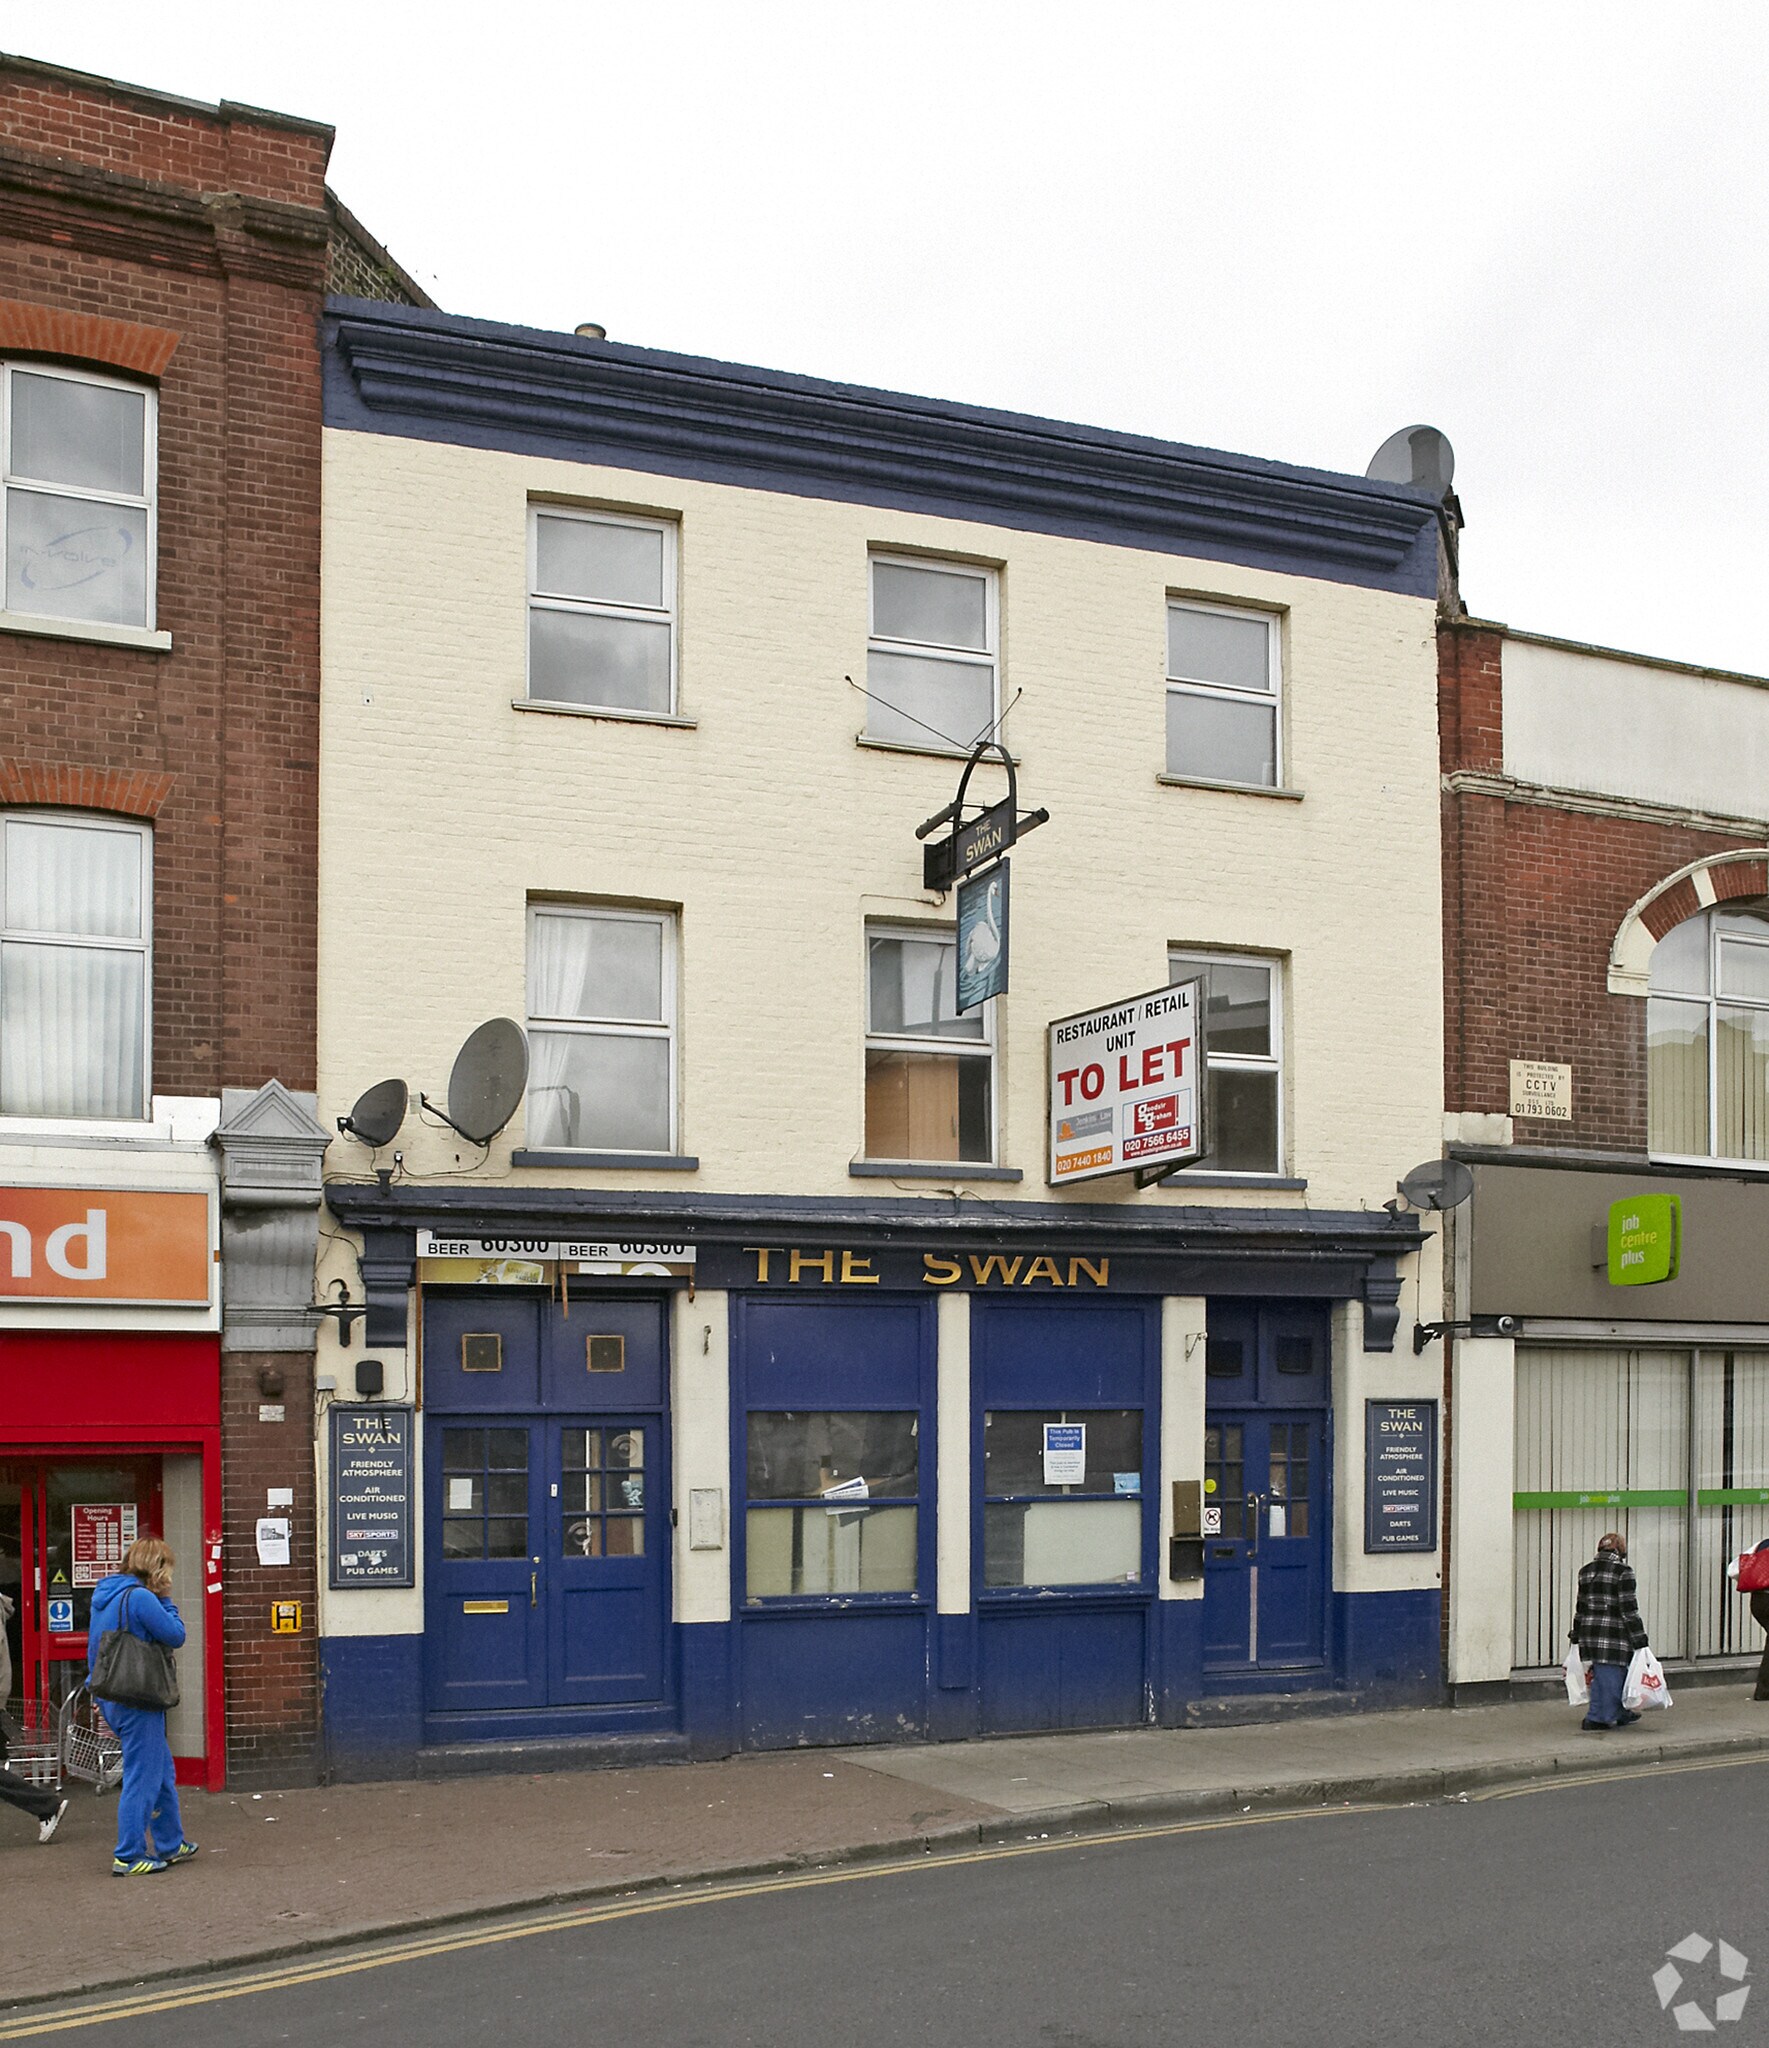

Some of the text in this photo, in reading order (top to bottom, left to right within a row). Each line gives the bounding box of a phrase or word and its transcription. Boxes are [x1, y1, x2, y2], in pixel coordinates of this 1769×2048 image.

[975, 818, 991, 838] THE
[966, 826, 1002, 862] SWAN
[1056, 1007, 1135, 1044] RESTAURANT
[1145, 992, 1190, 1019] RETAIL
[1106, 1030, 1136, 1052] UNIT
[1057, 1037, 1191, 1106] TO LET
[1526, 1079, 1556, 1091] CCTV
[1545, 1105, 1567, 1117] 0602
[1125, 1129, 1189, 1152] 020 7566 6455
[1057, 1150, 1111, 1171] 020 7440 1840
[1622, 1214, 1640, 1234] job
[1621, 1231, 1657, 1249] centre
[428, 1243, 469, 1255] BEER
[569, 1245, 609, 1257] BEER
[1621, 1250, 1645, 1270] plus
[743, 1247, 1110, 1287] THE SWAN
[1388, 1409, 1416, 1419] THE
[352, 1418, 392, 1429] THE
[1380, 1421, 1423, 1432] SWAN
[342, 1433, 401, 1444] SWAN
[350, 1460, 394, 1468] FRIENDLY
[342, 1469, 403, 1477] ATMOSPHERE
[364, 1486, 381, 1494] AIR
[339, 1495, 406, 1503] CONDITIONED
[83, 1507, 112, 1515] Opening
[368, 1512, 399, 1520] MUSIC
[1396, 1534, 1419, 1542] GAMES
[357, 1550, 388, 1558] DARTS
[346, 1567, 399, 1575] PUB GAMES
